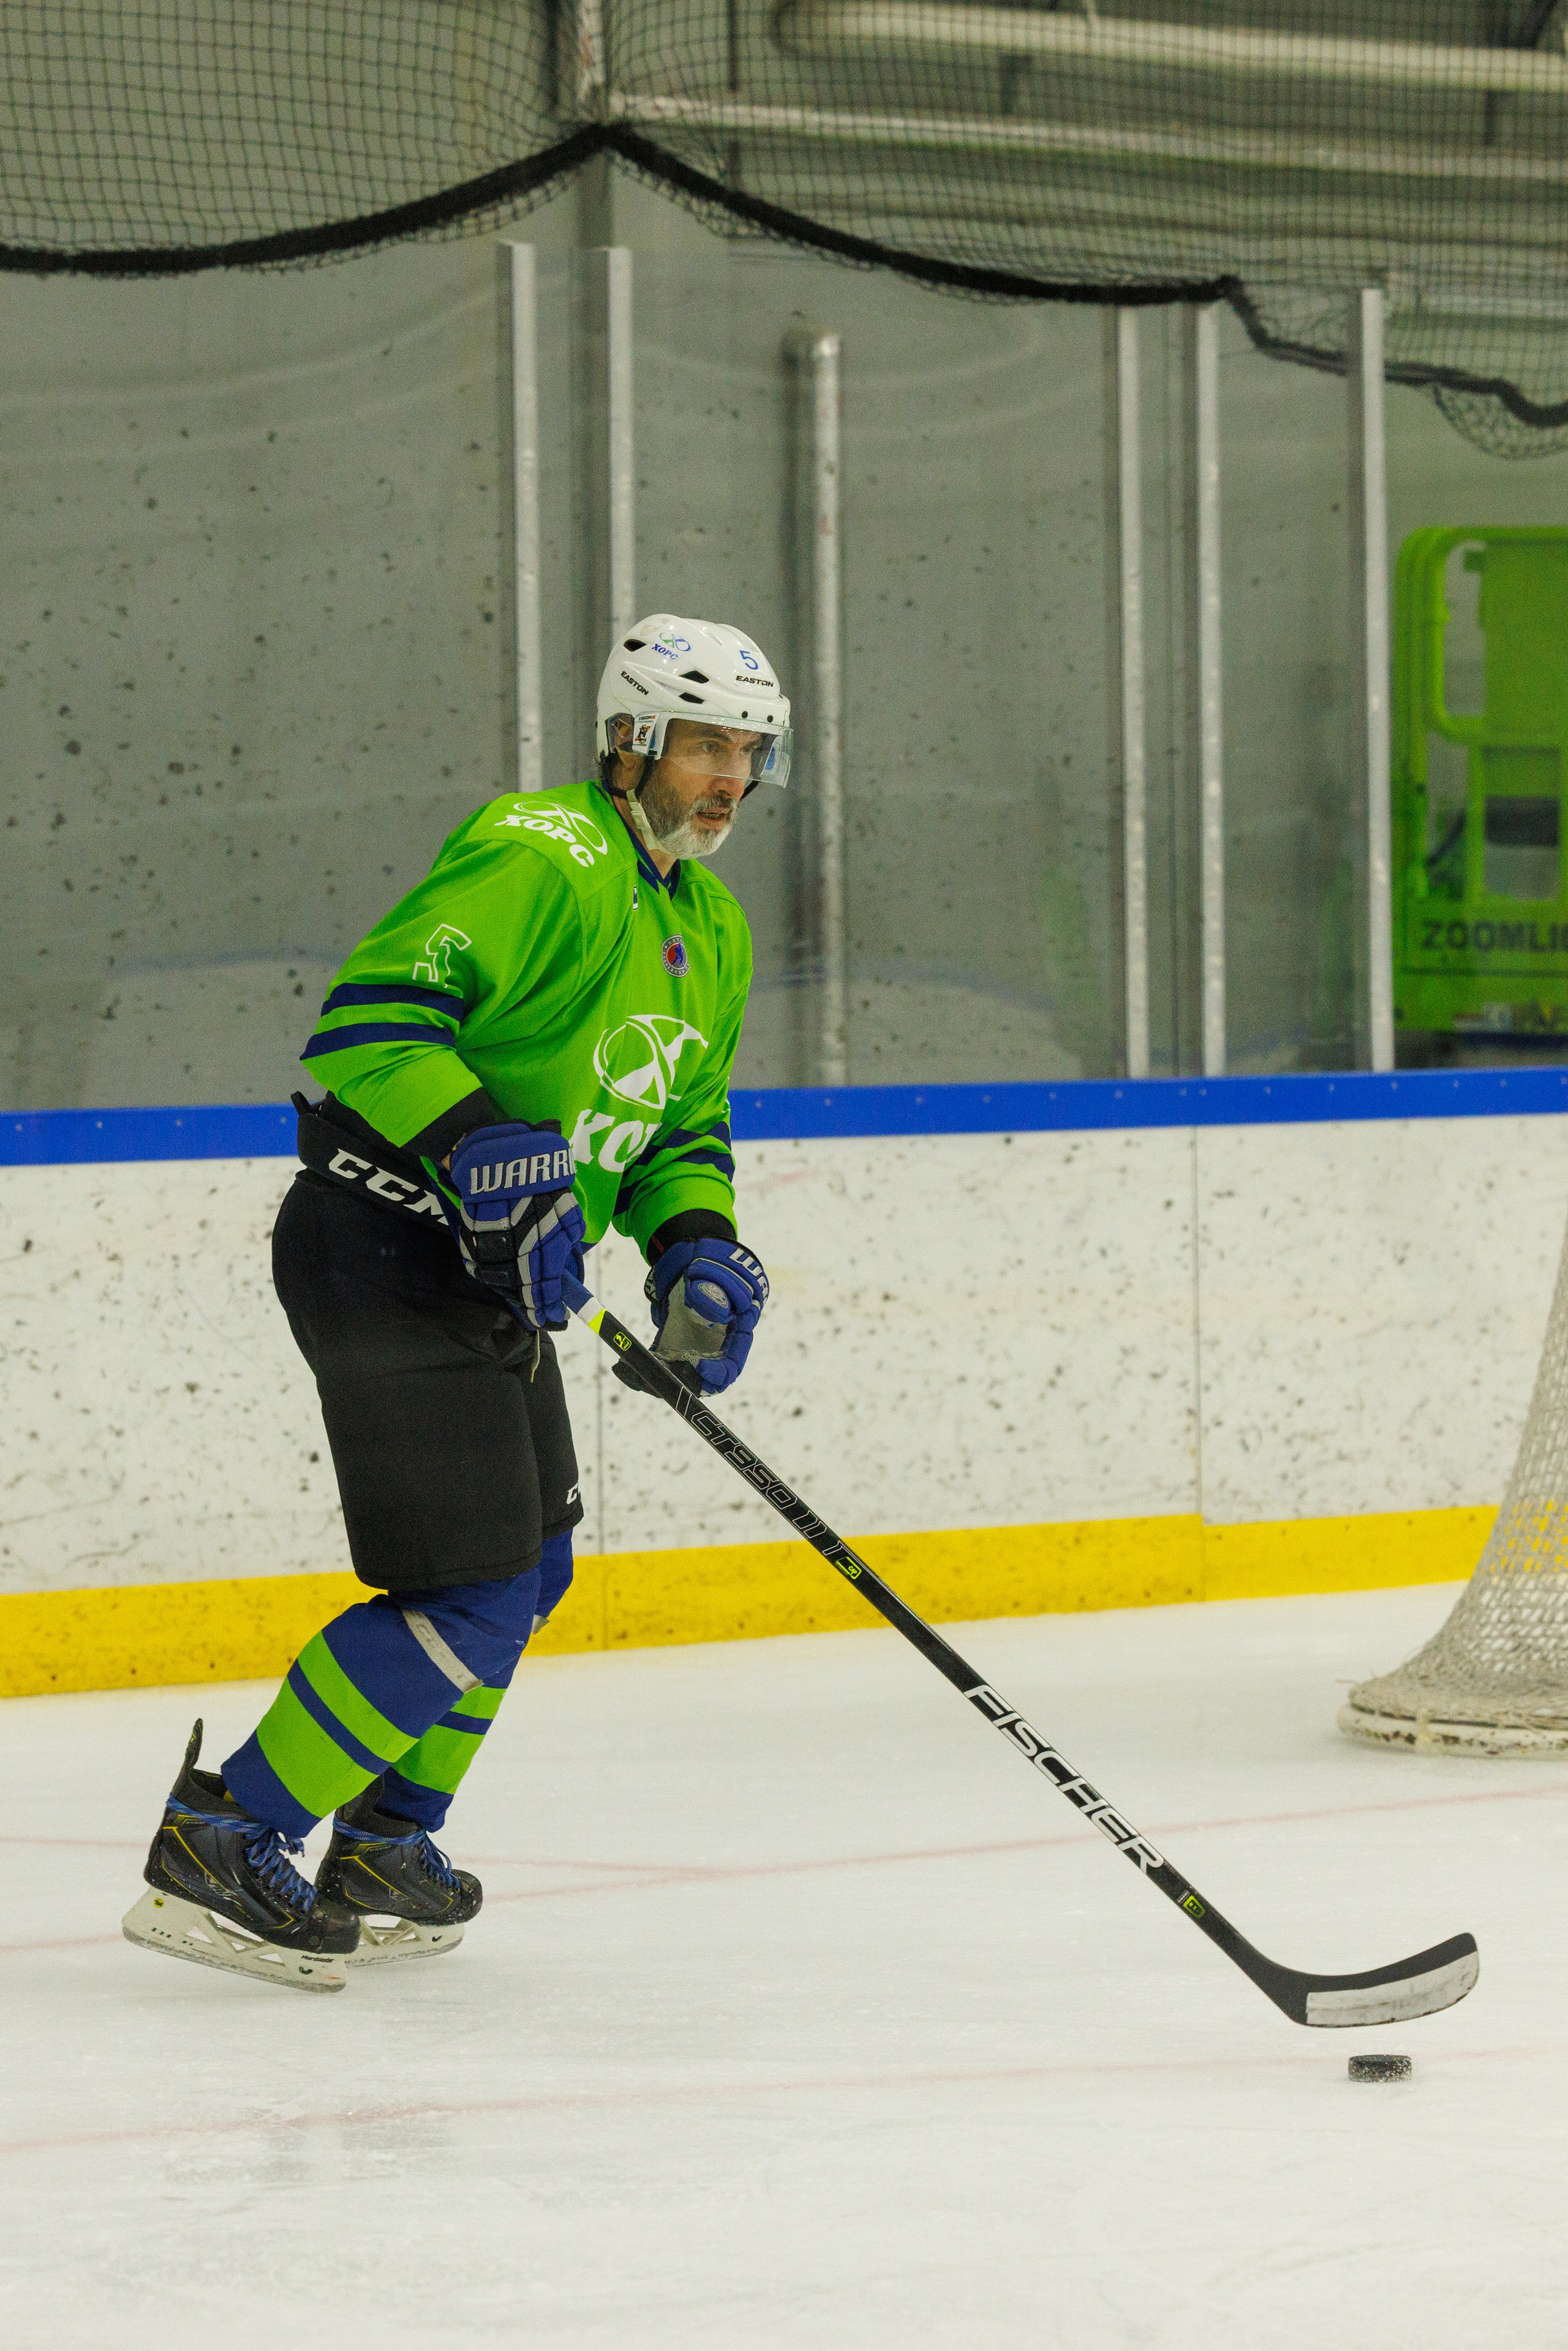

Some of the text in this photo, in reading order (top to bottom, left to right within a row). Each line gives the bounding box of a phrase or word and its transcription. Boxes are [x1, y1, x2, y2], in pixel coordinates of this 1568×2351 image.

[651, 643, 679, 661] ХОРС
[739, 650, 759, 670] 5
[620, 671, 649, 695] EASTON
[736, 675, 774, 687] EASTON
[494, 814, 595, 867] ХОРС
[470, 1147, 577, 1194] WARRI
[963, 1684, 1164, 1876] FISCHER
